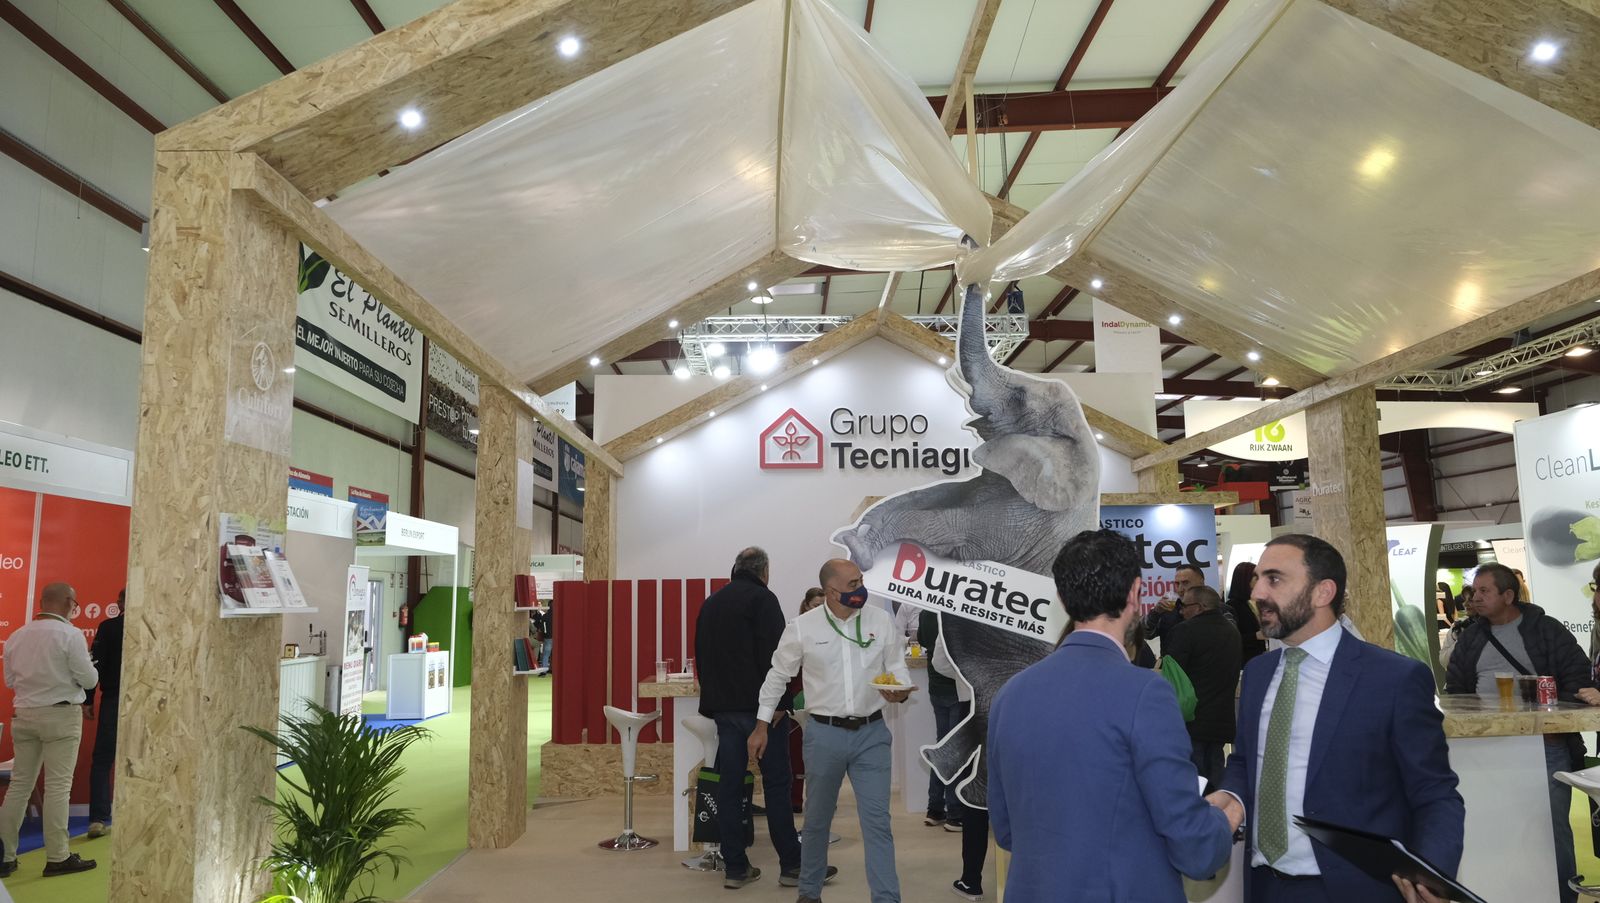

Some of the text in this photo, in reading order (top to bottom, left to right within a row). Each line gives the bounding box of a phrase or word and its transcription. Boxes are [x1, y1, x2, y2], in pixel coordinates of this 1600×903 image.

[331, 268, 415, 344] El Plantel
[296, 324, 306, 341] EL
[306, 330, 334, 356] MEJOR
[334, 344, 359, 371] INJERTO
[359, 361, 375, 380] PARA
[383, 375, 405, 397] COSECHA
[329, 301, 412, 366] SEMILLEROS
[829, 407, 929, 442] Grupo
[1249, 443, 1293, 452] RIJK ZWAAN
[25, 454, 49, 473] ETT.
[1392, 547, 1418, 557] LEAF
[887, 582, 1045, 636] DURA MÁS, RESISTE MÁS
[892, 542, 1051, 622] Duratec
